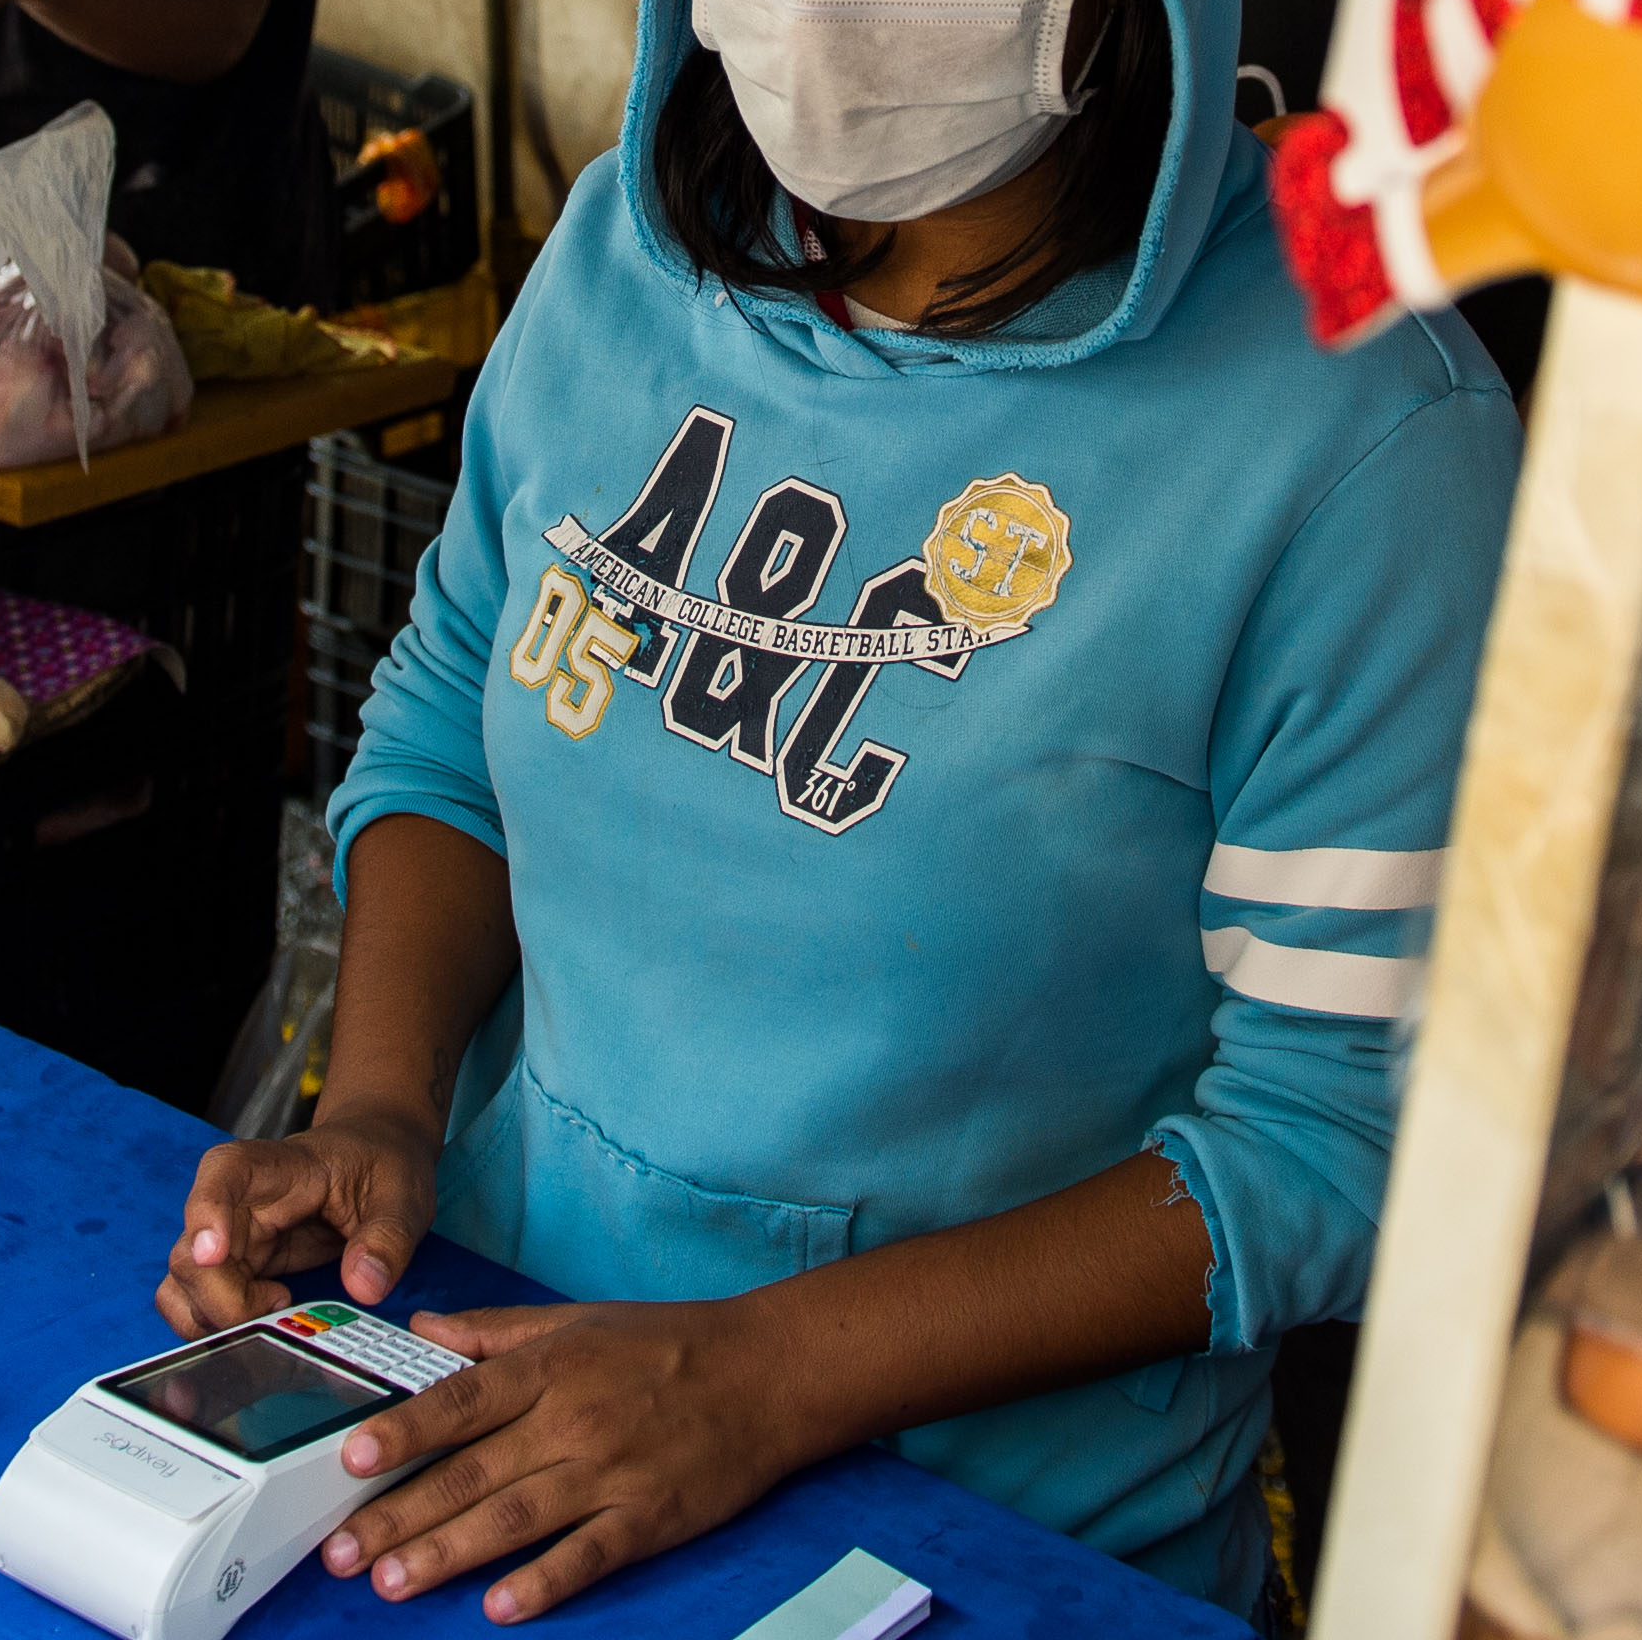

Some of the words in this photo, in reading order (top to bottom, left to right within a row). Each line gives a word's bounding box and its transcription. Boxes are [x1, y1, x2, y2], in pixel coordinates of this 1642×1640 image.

[570, 540, 666, 611] AMERICAN
[676, 597, 765, 644] COLLEGE
[771, 624, 915, 658] BASKETBALL
[949, 506, 1049, 598] ST
[510, 563, 641, 740] 05
